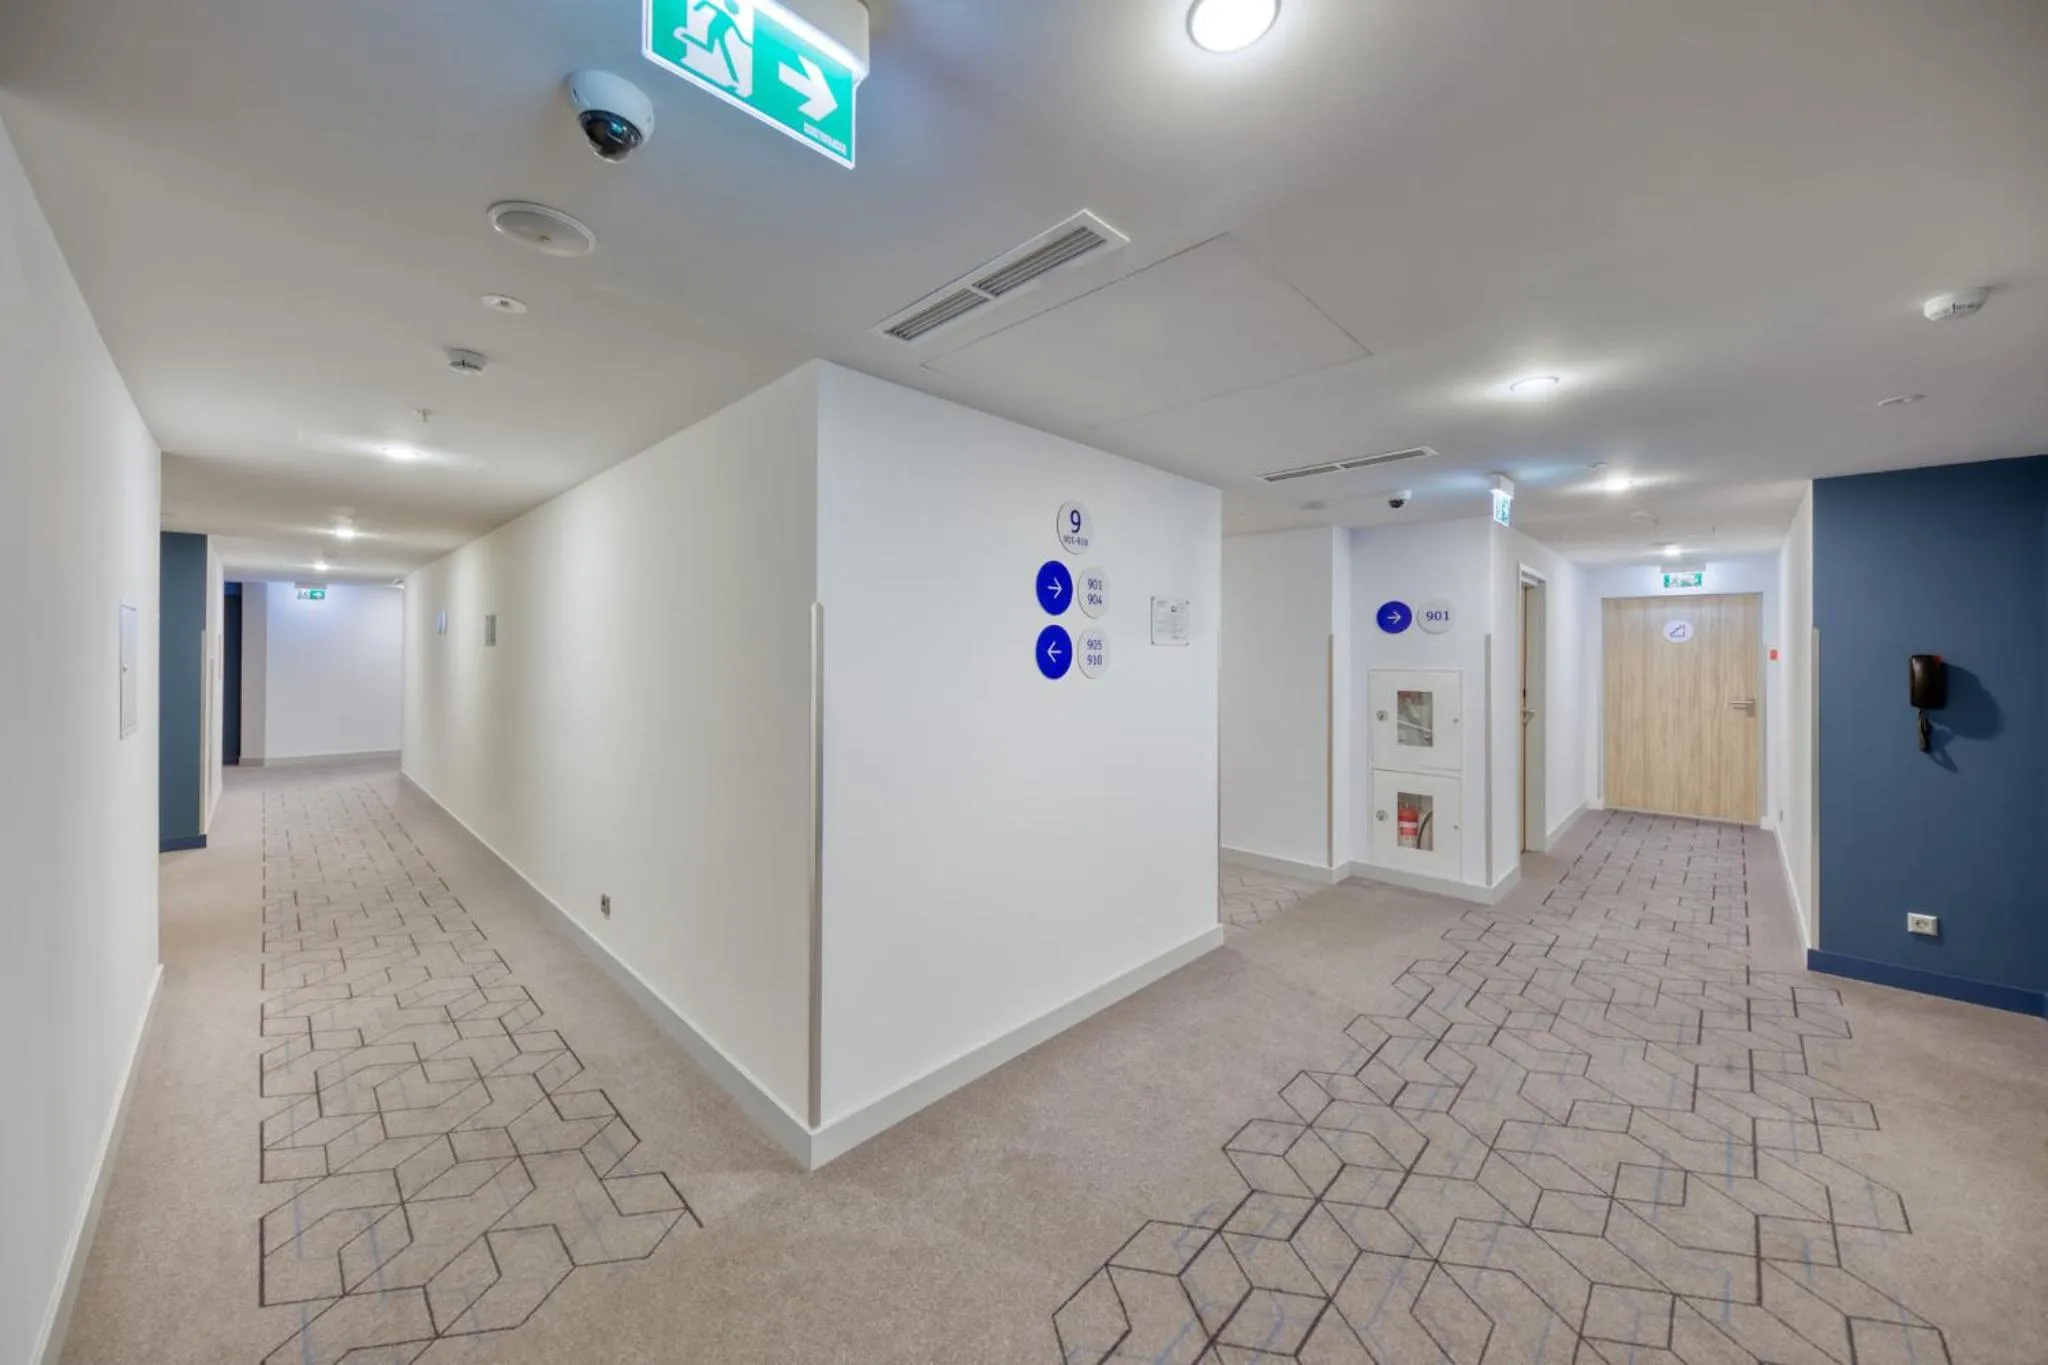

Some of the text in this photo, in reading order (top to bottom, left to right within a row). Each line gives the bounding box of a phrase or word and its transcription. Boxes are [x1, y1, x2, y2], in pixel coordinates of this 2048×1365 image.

[1070, 509, 1081, 534] 9
[1087, 578, 1102, 590] 901
[1087, 593, 1102, 605] 904
[1426, 611, 1449, 621] 901
[1087, 639, 1102, 650] 905
[1087, 654, 1102, 665] 910
